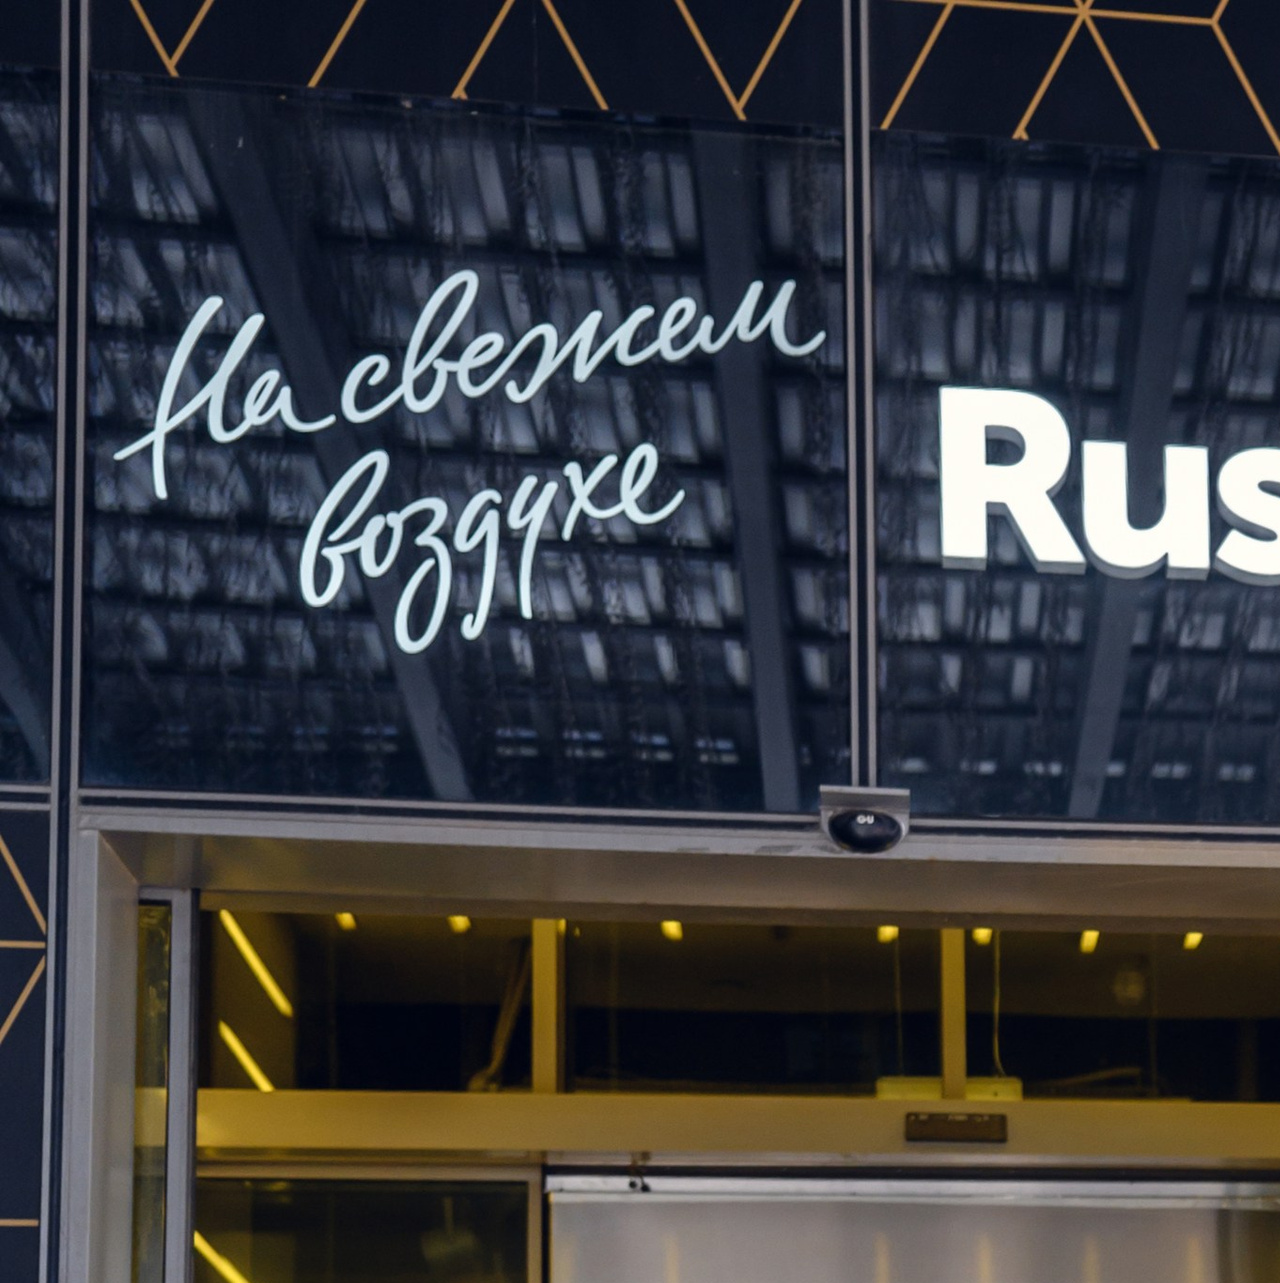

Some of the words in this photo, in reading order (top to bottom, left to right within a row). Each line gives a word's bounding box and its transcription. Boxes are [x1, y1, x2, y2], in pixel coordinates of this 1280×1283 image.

[113, 295, 335, 499] На
[341, 269, 825, 424] свежем
[299, 442, 685, 653] воздухе
